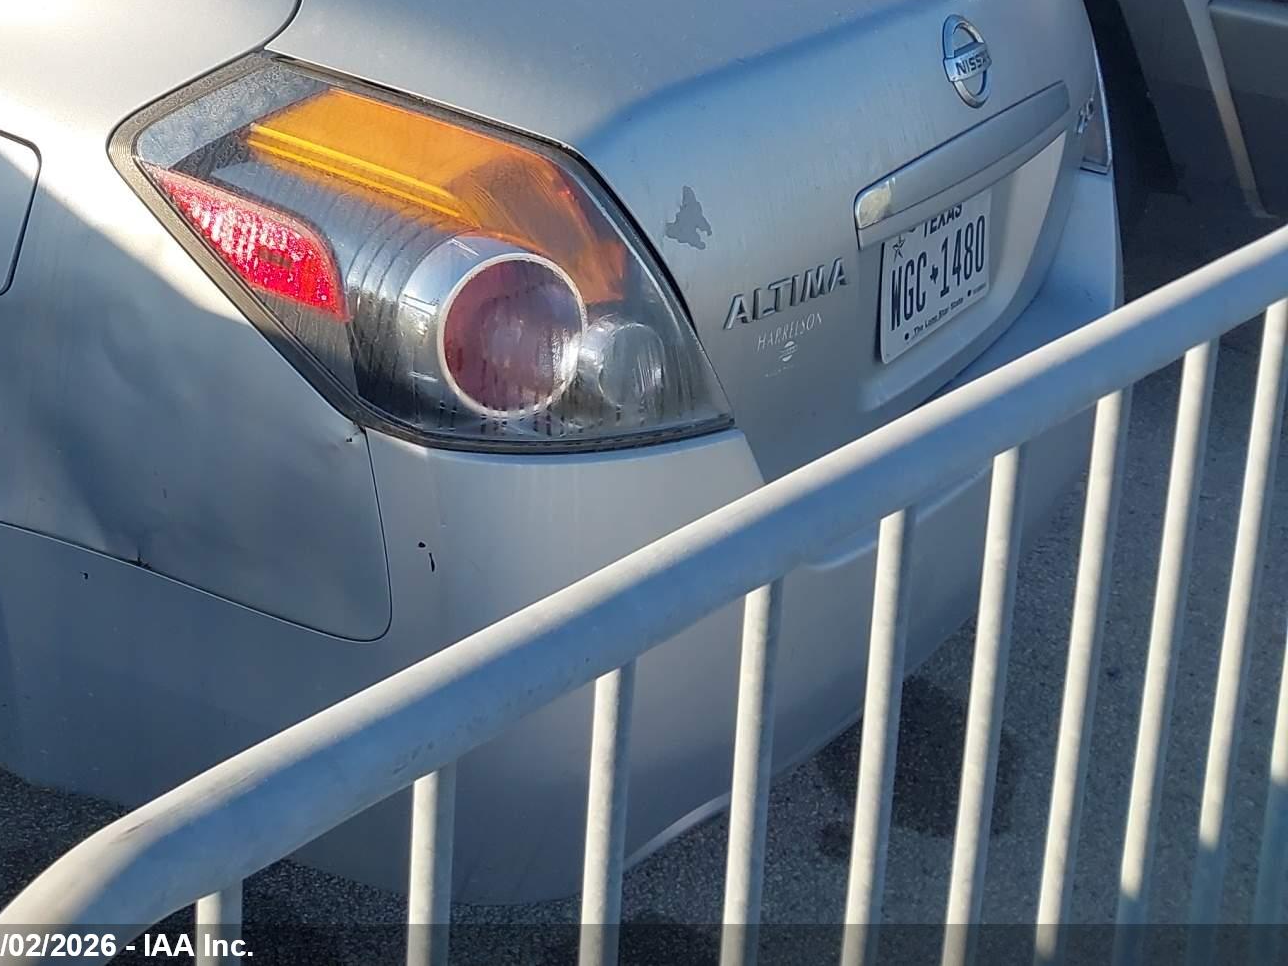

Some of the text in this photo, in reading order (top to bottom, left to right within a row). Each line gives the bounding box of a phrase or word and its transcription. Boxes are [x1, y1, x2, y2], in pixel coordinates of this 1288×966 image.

[955, 52, 989, 76] NISS
[722, 256, 848, 330] ALTIMA
[890, 214, 986, 331] WGC 1480
